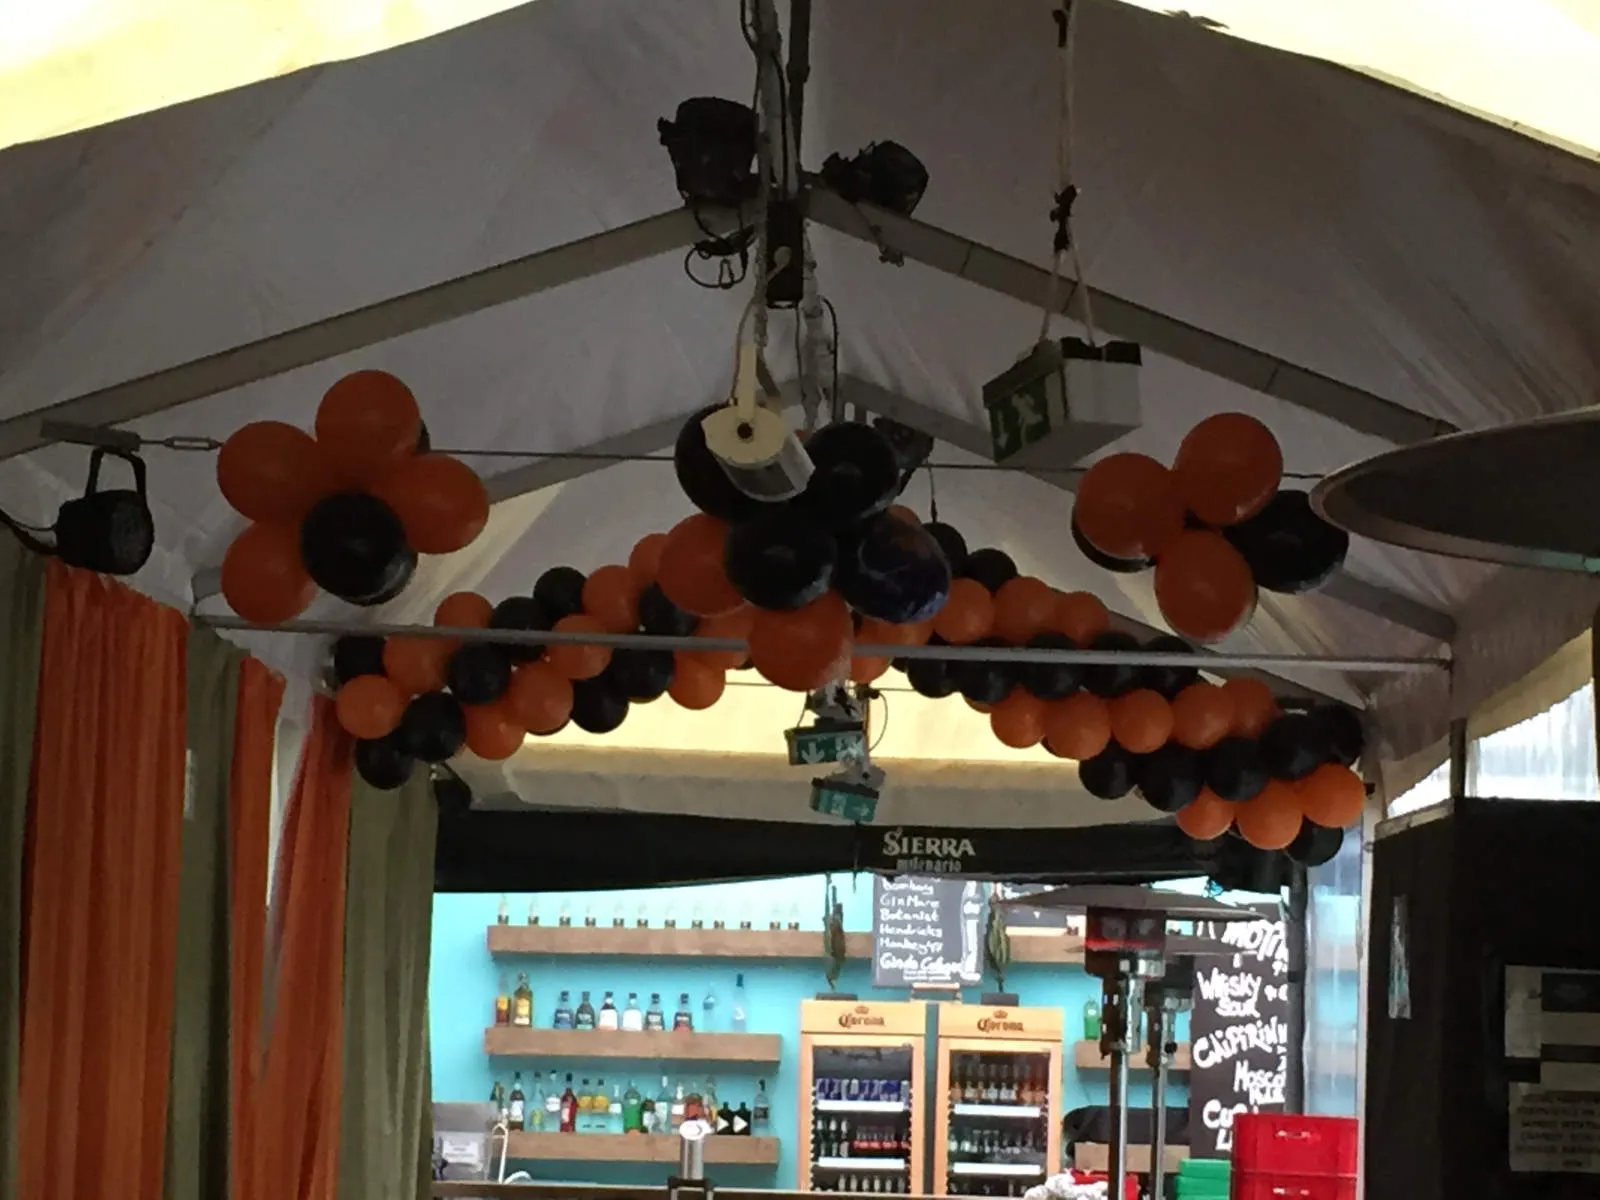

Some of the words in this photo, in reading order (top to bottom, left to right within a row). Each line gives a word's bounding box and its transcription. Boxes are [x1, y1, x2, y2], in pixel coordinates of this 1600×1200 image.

[882, 827, 977, 858] SIERRA
[838, 1013, 886, 1028] Corona
[976, 1018, 1025, 1033] Corona
